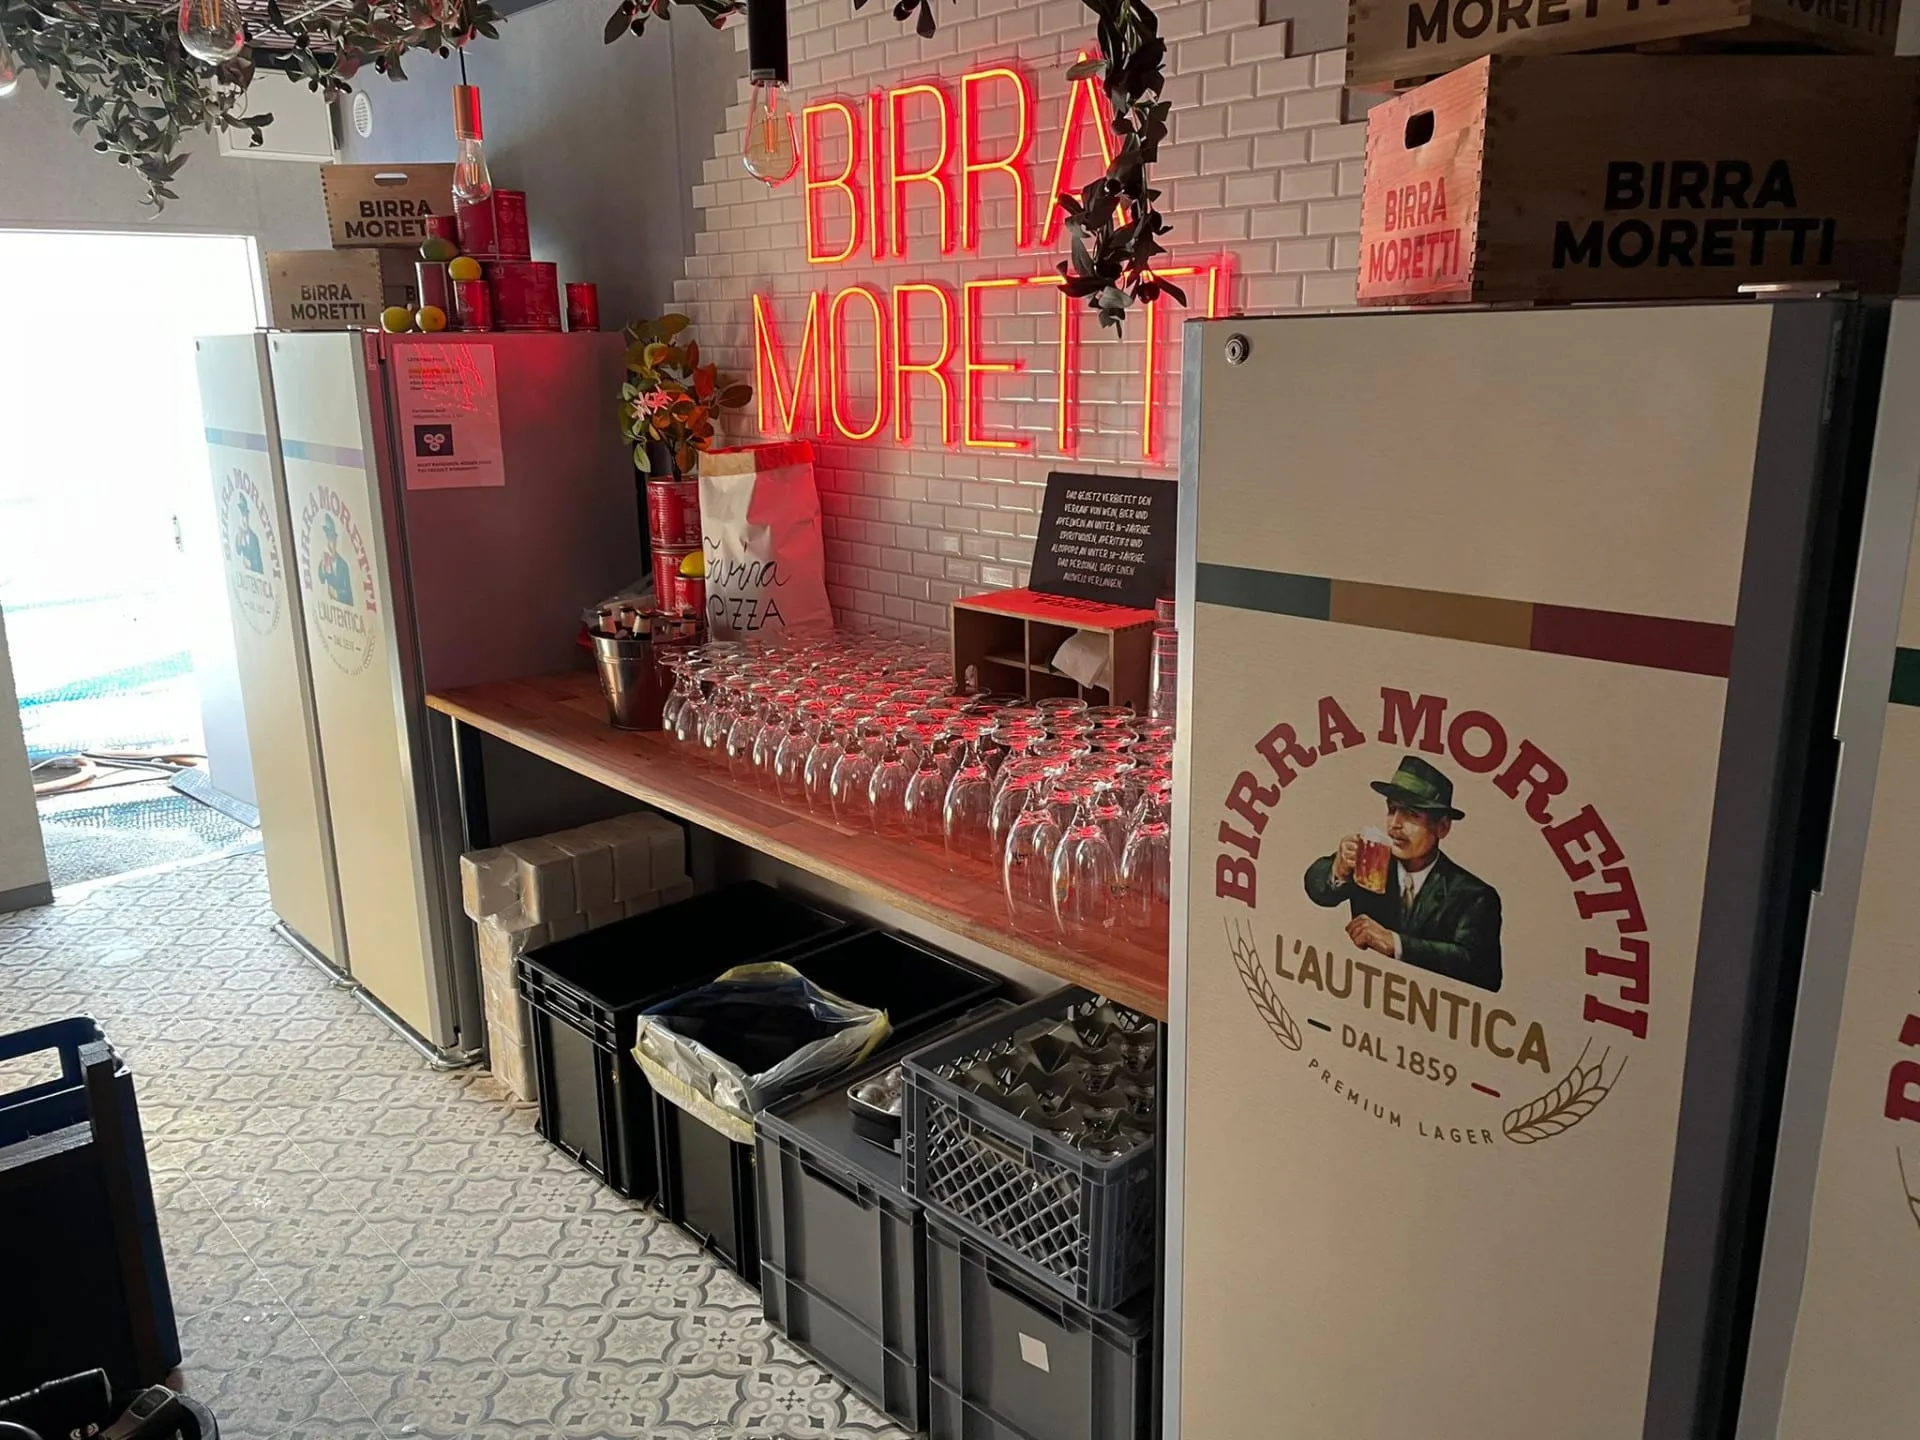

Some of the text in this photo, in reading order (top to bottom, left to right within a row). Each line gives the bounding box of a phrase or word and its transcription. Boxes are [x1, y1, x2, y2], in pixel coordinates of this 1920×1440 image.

[1407, 0, 1670, 48] MORE
[801, 50, 1130, 264] BIRRA
[1384, 176, 1447, 233] BIRRA
[1603, 159, 1798, 212] BIRRA
[345, 219, 427, 239] MORET
[360, 199, 433, 218] BIRRA
[1368, 227, 1461, 283] MORETTI
[1552, 217, 1837, 270] MORETTI
[290, 303, 367, 321] MORETTI
[300, 283, 353, 301] BIRRA
[1064, 503, 1089, 514] VERKAUF
[1090, 505, 1102, 515] VON
[1119, 508, 1135, 519] BIER
[1135, 510, 1149, 520] UND
[1078, 491, 1101, 502] GESETZ
[1102, 493, 1137, 504] VERBIETET
[1138, 495, 1152, 505] DEN
[1094, 520, 1115, 531] UNTER
[1130, 538, 1144, 548] UND
[317, 484, 376, 614] MORETTI
[1087, 547, 1109, 558] UNTER
[1100, 563, 1115, 573] DARF
[706, 594, 786, 630] PZZA
[1216, 686, 1651, 1040] BIRRA MORETTI
[1275, 933, 1552, 1074] L'AUTENTICA
[1342, 1023, 1458, 1087] DAL 1859
[1308, 1057, 1494, 1145] PREMIUM LAGER
